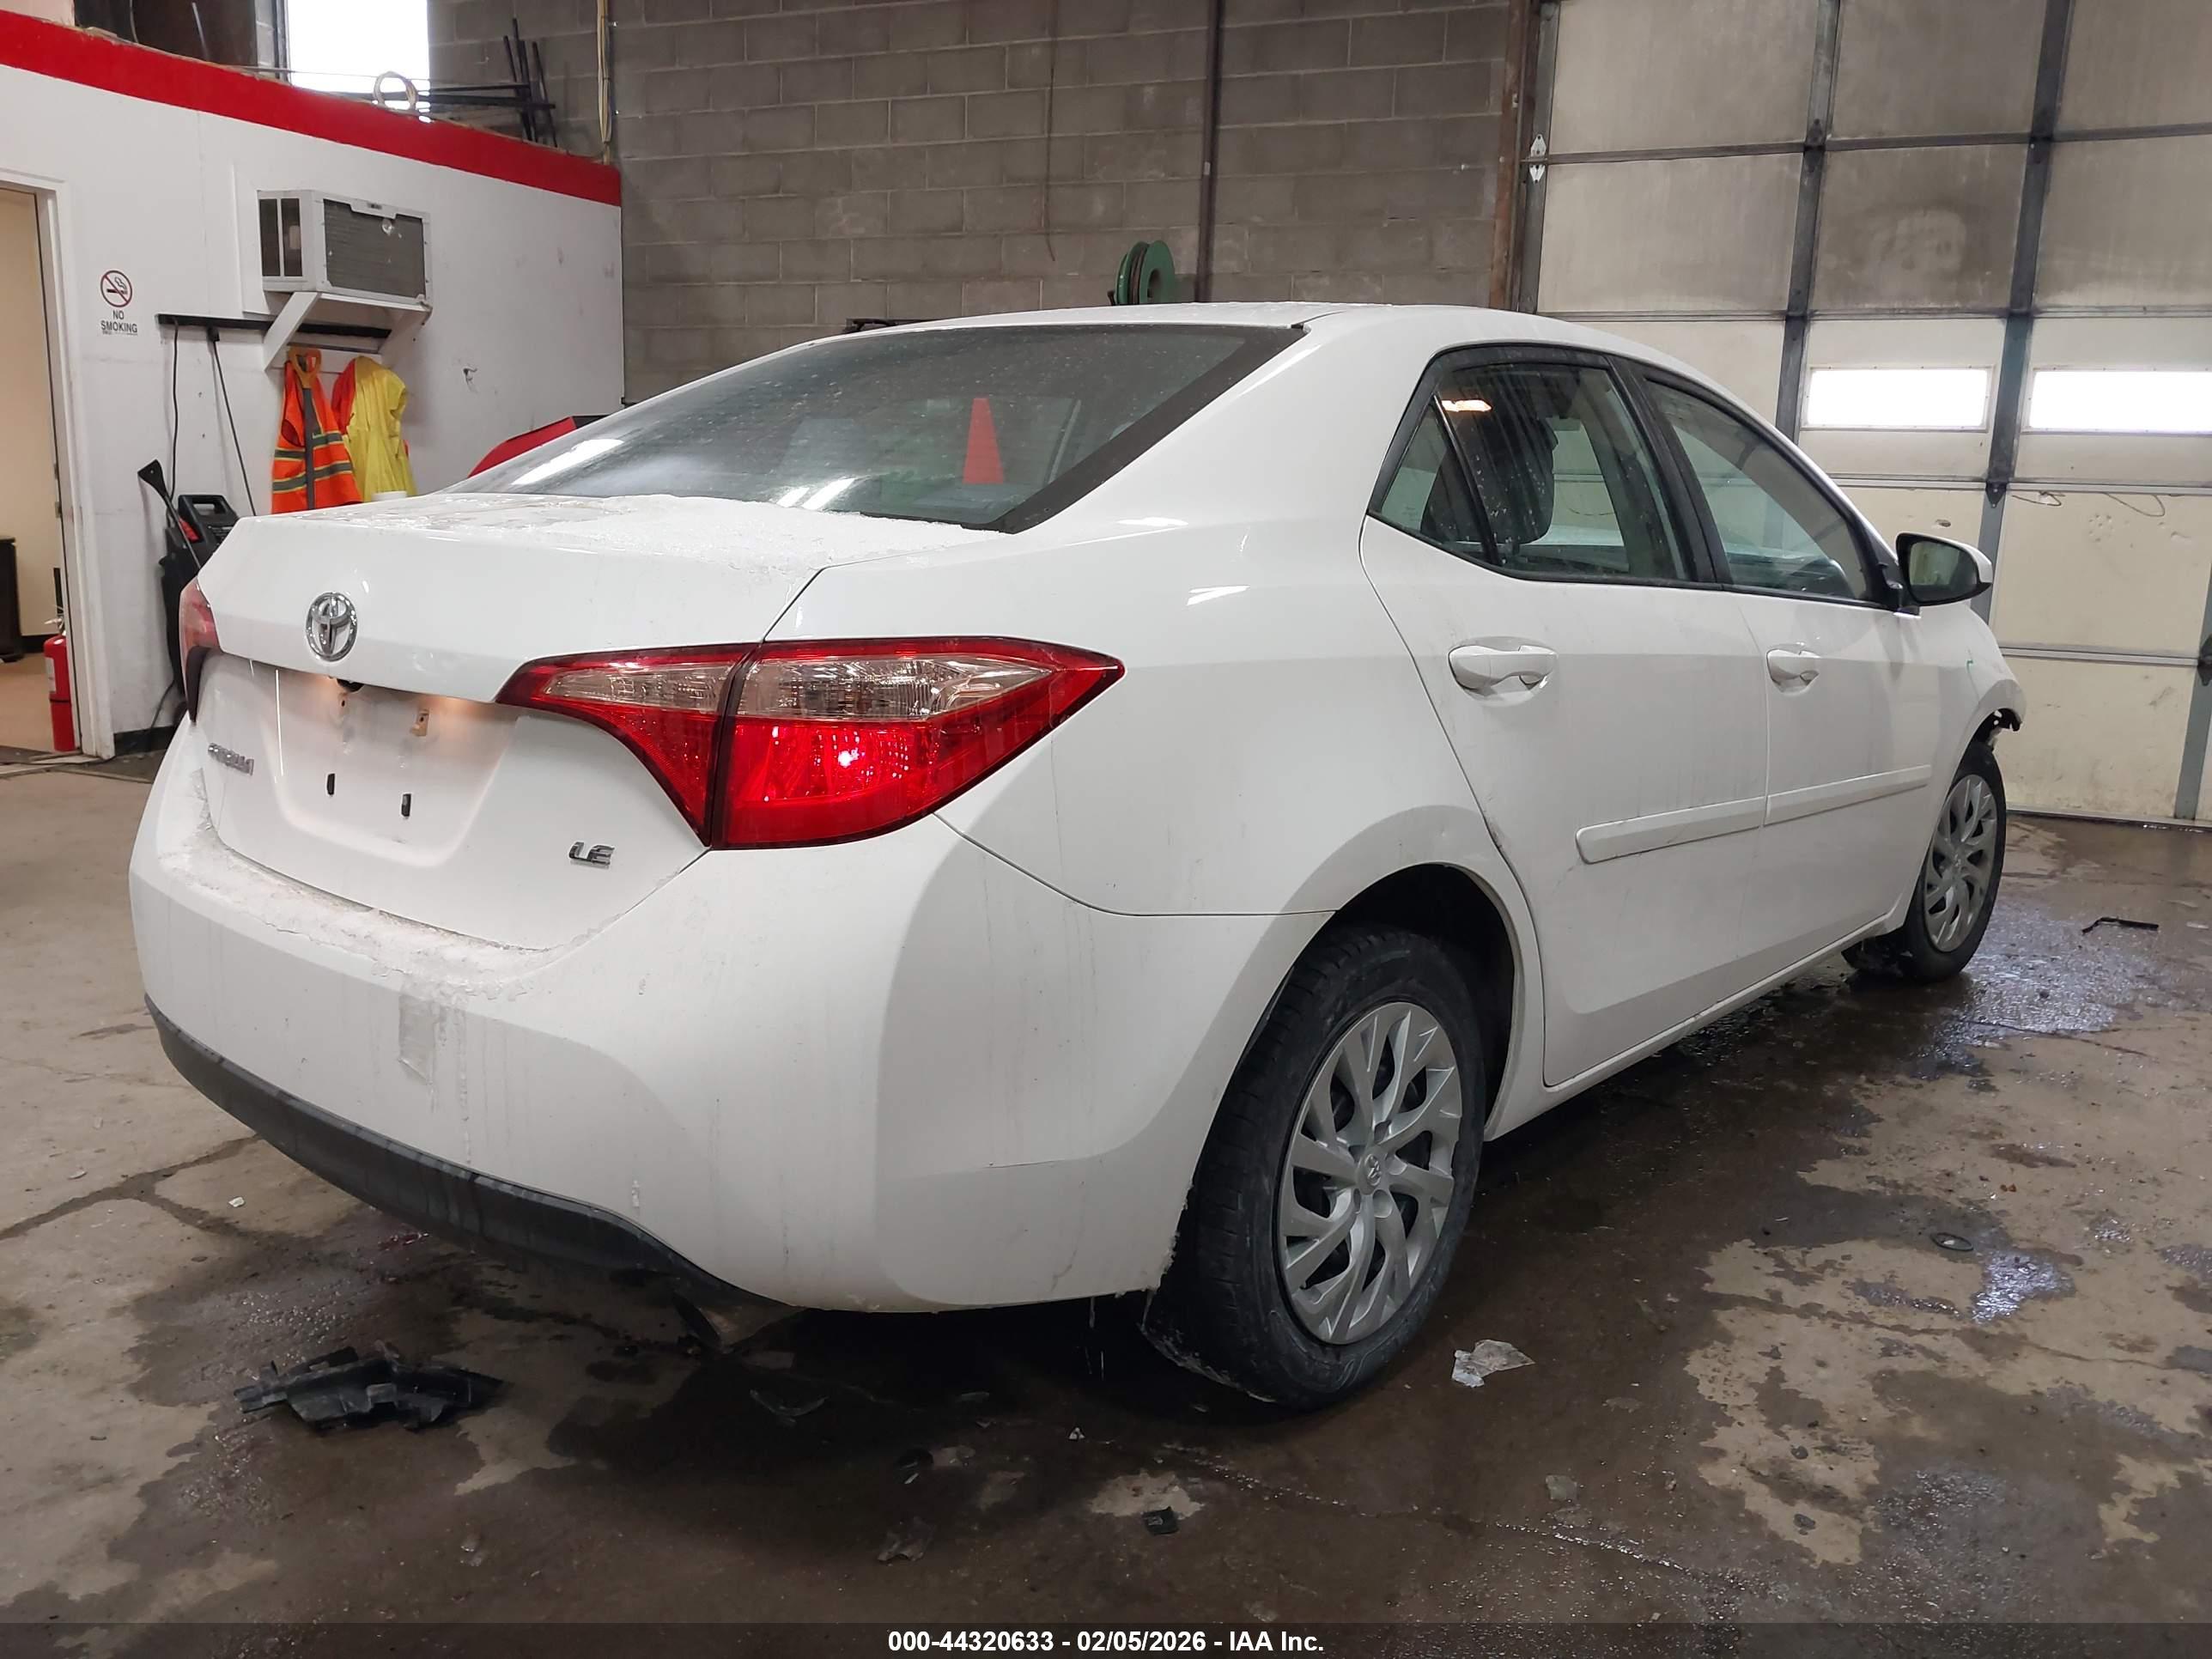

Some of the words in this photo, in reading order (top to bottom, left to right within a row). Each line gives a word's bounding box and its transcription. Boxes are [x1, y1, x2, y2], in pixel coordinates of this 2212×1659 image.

[112, 310, 125, 319] NO
[100, 320, 137, 332] SMOKING
[568, 841, 615, 866] LE
